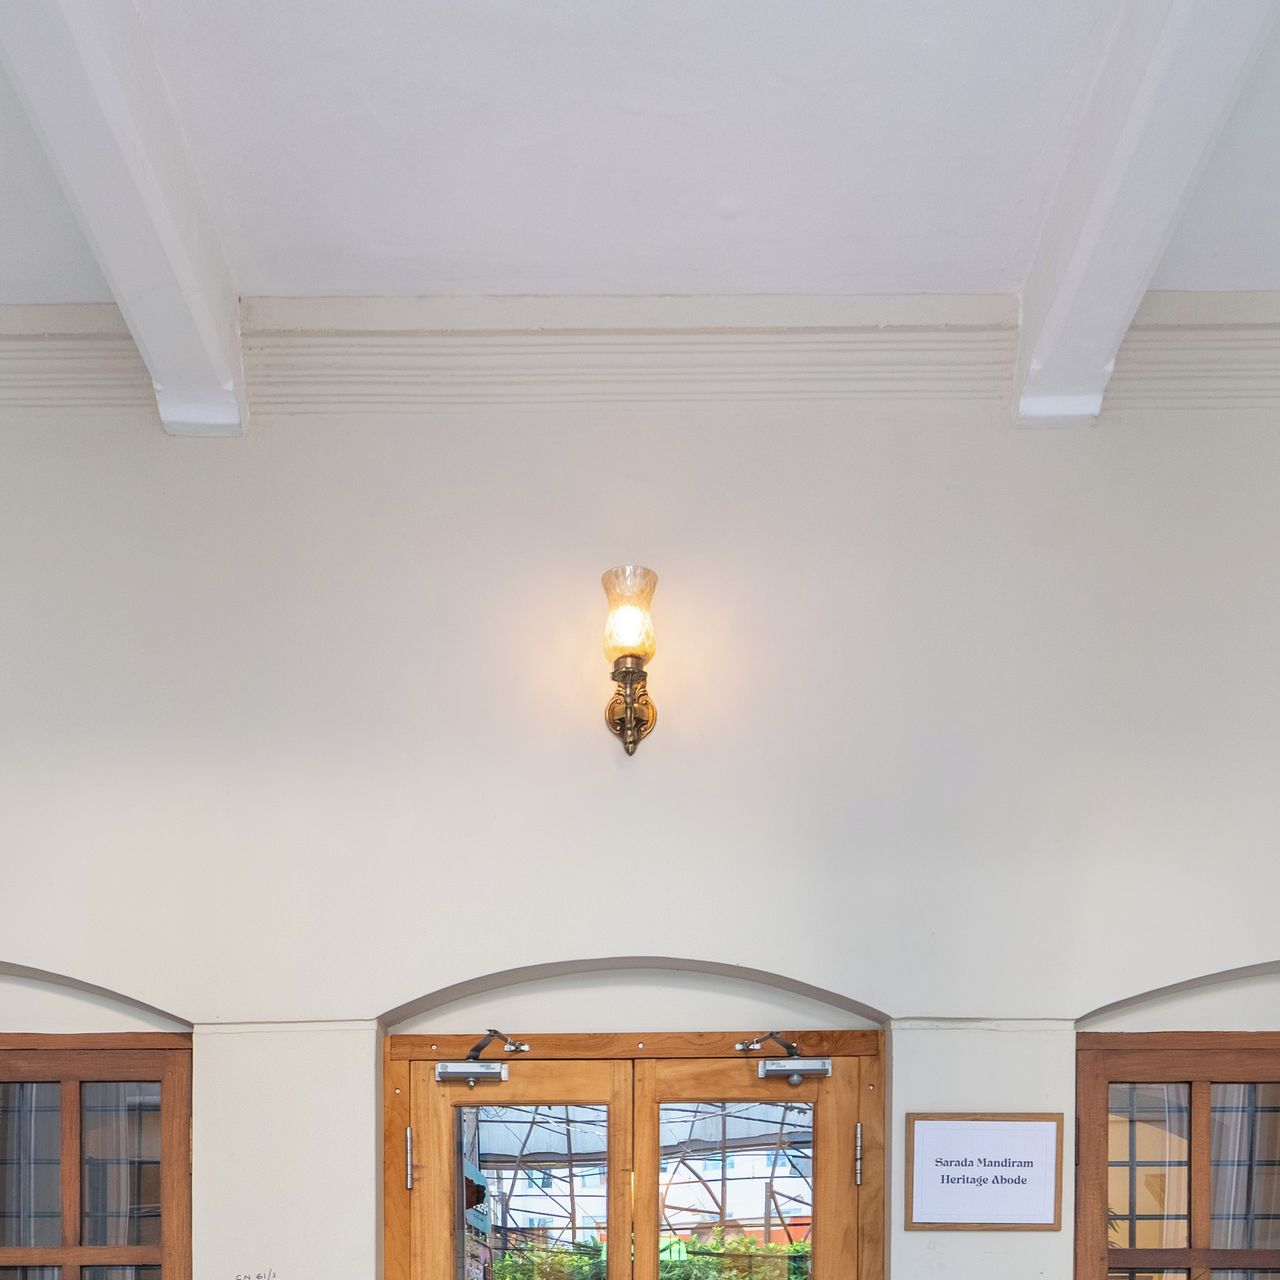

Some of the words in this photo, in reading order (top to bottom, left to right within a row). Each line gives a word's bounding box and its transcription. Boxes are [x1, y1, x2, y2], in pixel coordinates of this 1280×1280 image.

[935, 1157, 974, 1167] Sarada
[977, 1158, 1034, 1168] Mandiram
[941, 1174, 989, 1187] Heritage
[991, 1175, 1027, 1185] Abode
